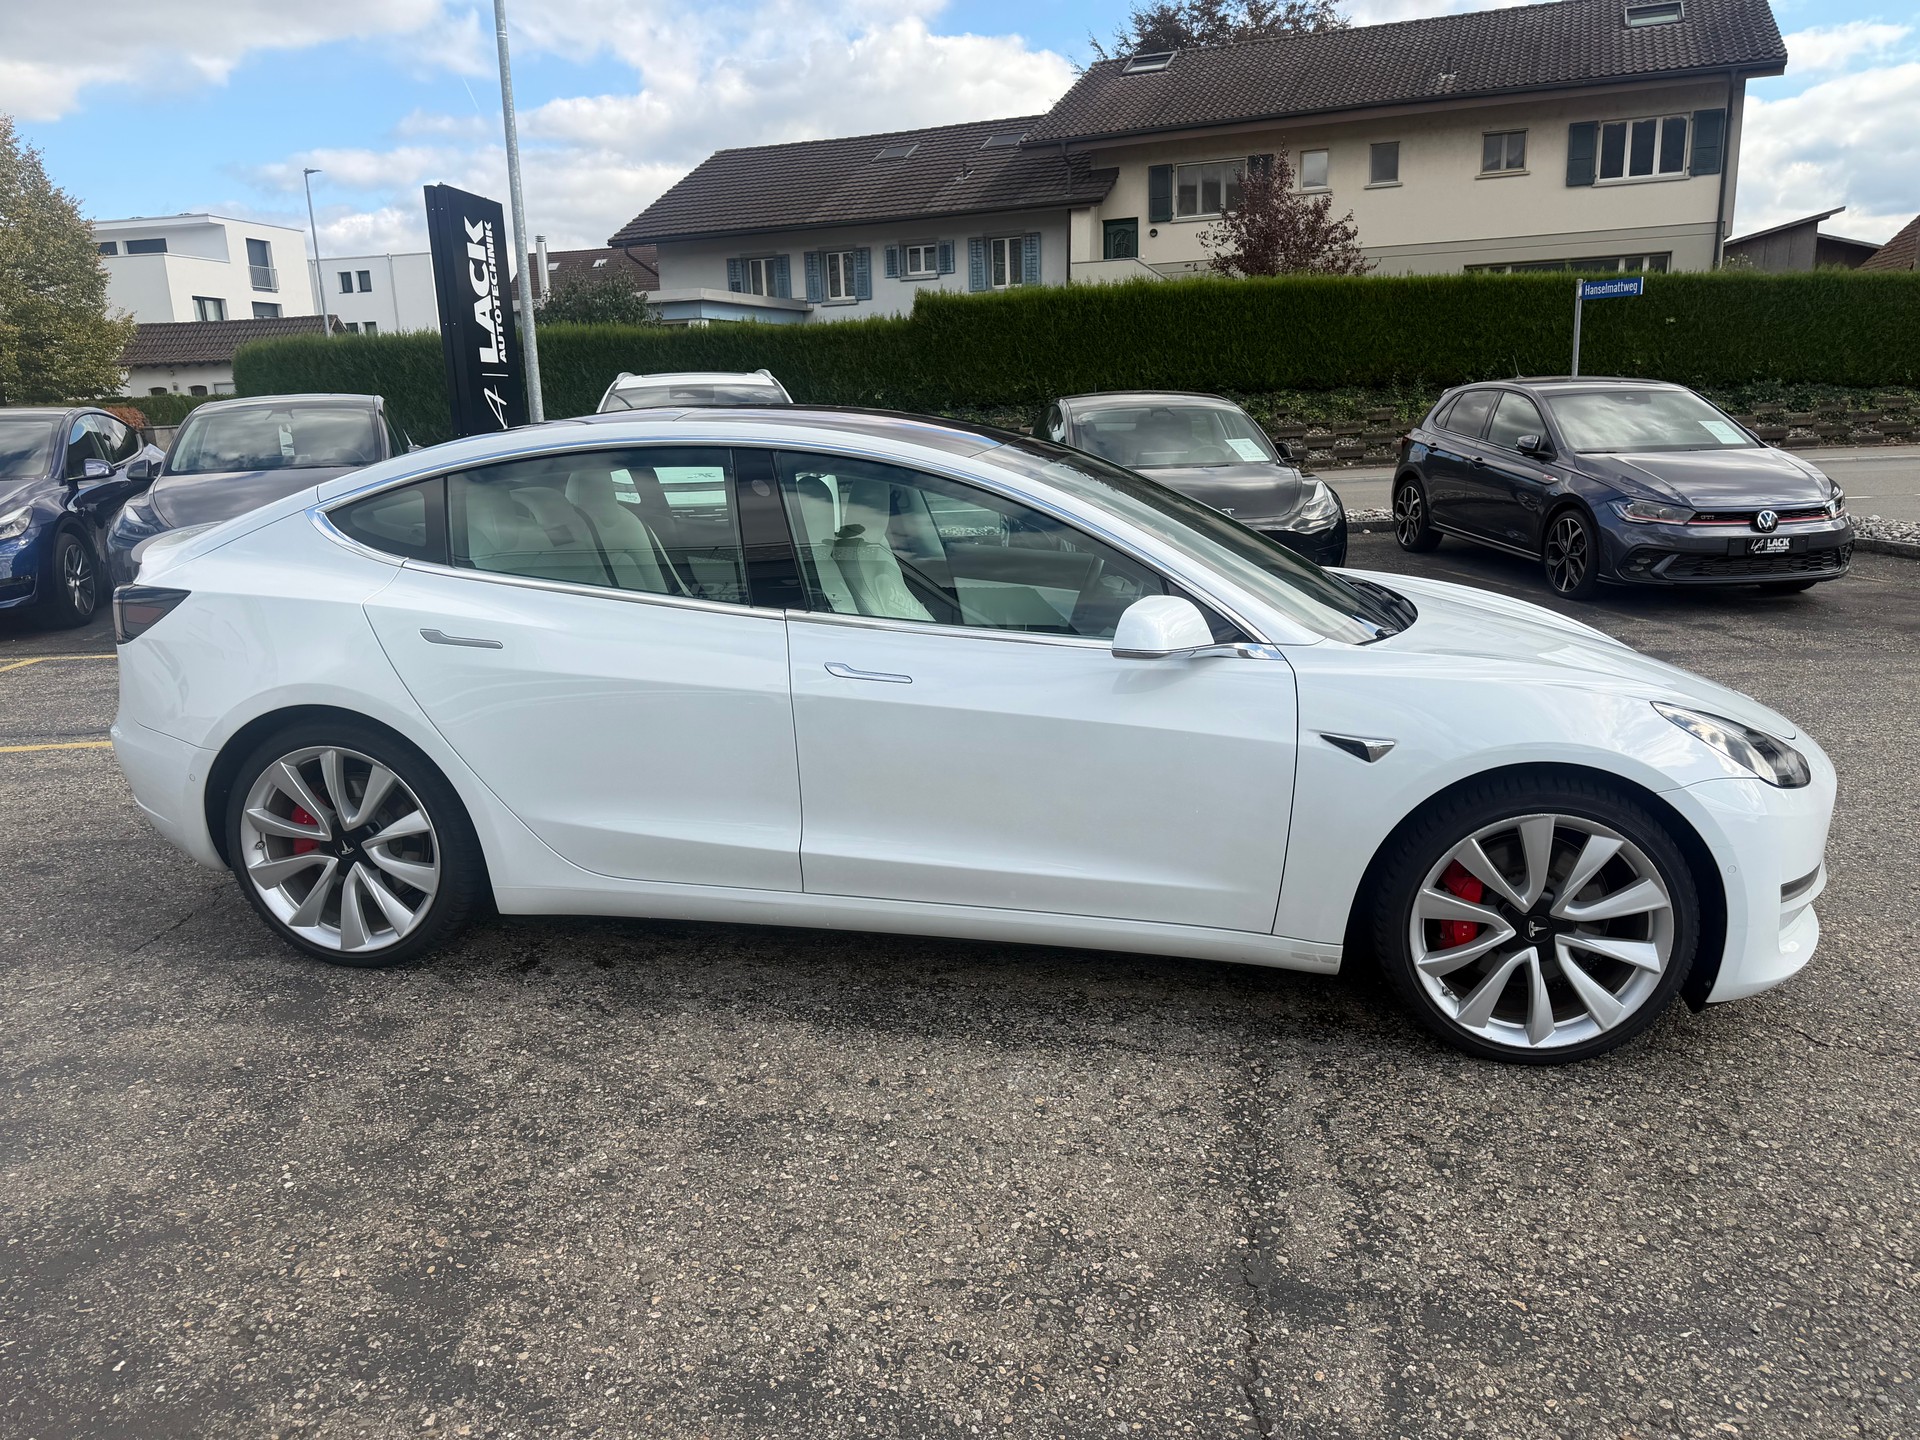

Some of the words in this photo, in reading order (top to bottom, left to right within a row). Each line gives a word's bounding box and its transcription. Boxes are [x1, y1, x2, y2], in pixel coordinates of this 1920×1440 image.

[464, 216, 499, 363] LACK
[484, 221, 508, 363] AUTOTECHNIK
[1584, 281, 1638, 296] Hanselmattweg
[1767, 537, 1790, 547] LACK
